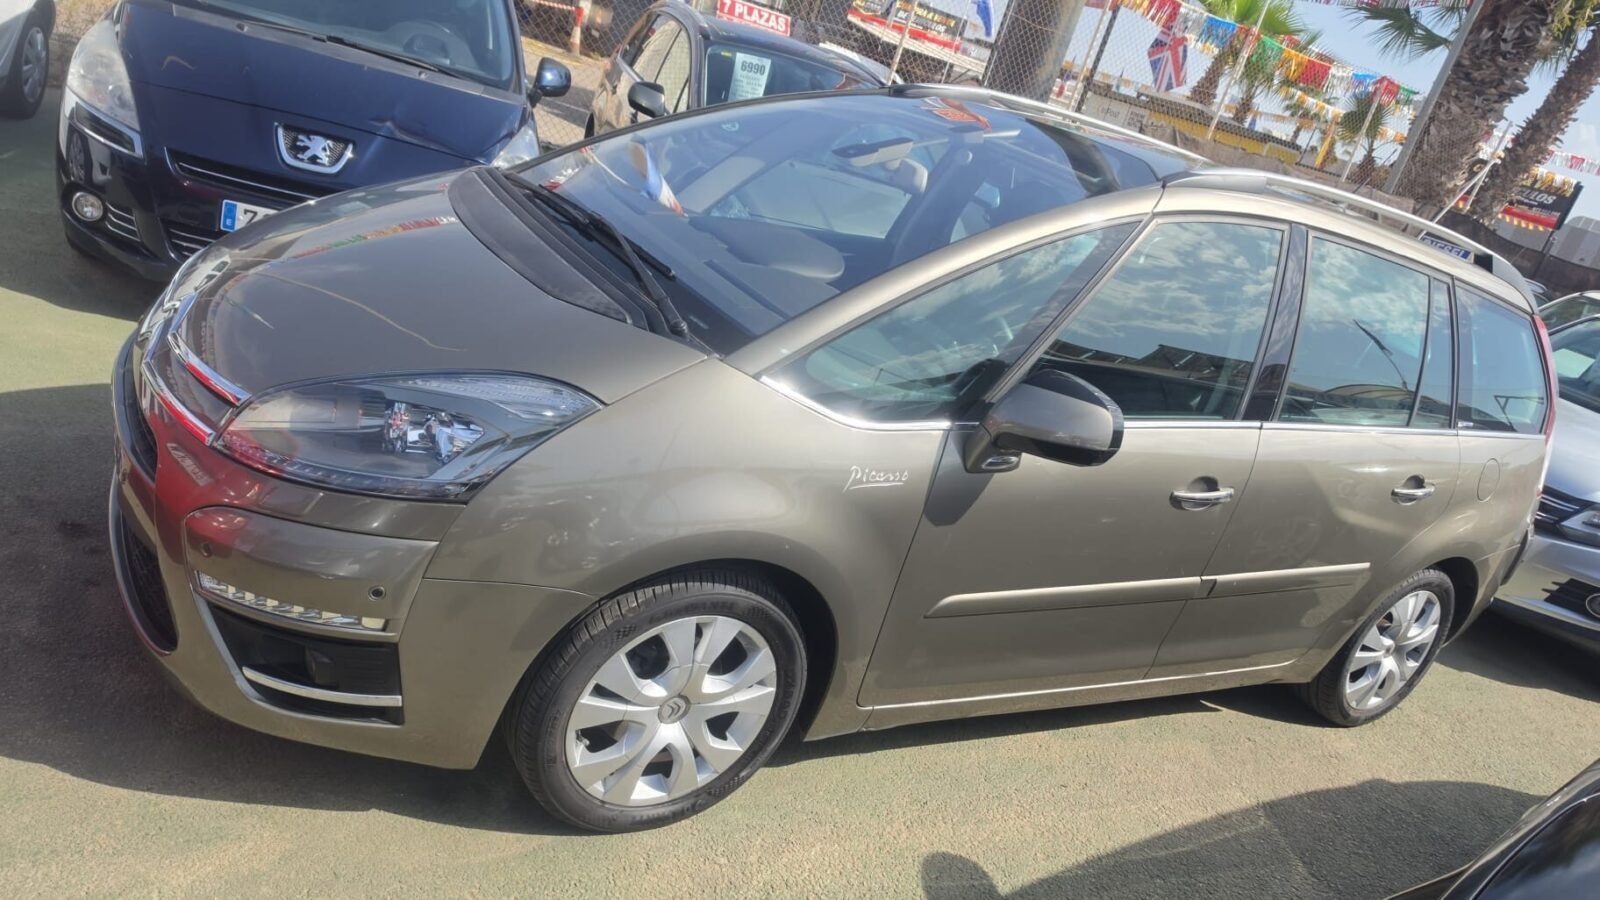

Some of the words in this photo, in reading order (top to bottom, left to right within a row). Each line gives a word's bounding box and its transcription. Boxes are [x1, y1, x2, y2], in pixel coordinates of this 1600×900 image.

[723, 0, 732, 13] 7
[734, 2, 786, 31] PLAZAS
[740, 60, 766, 76] 6990
[842, 465, 909, 494] Picasso
